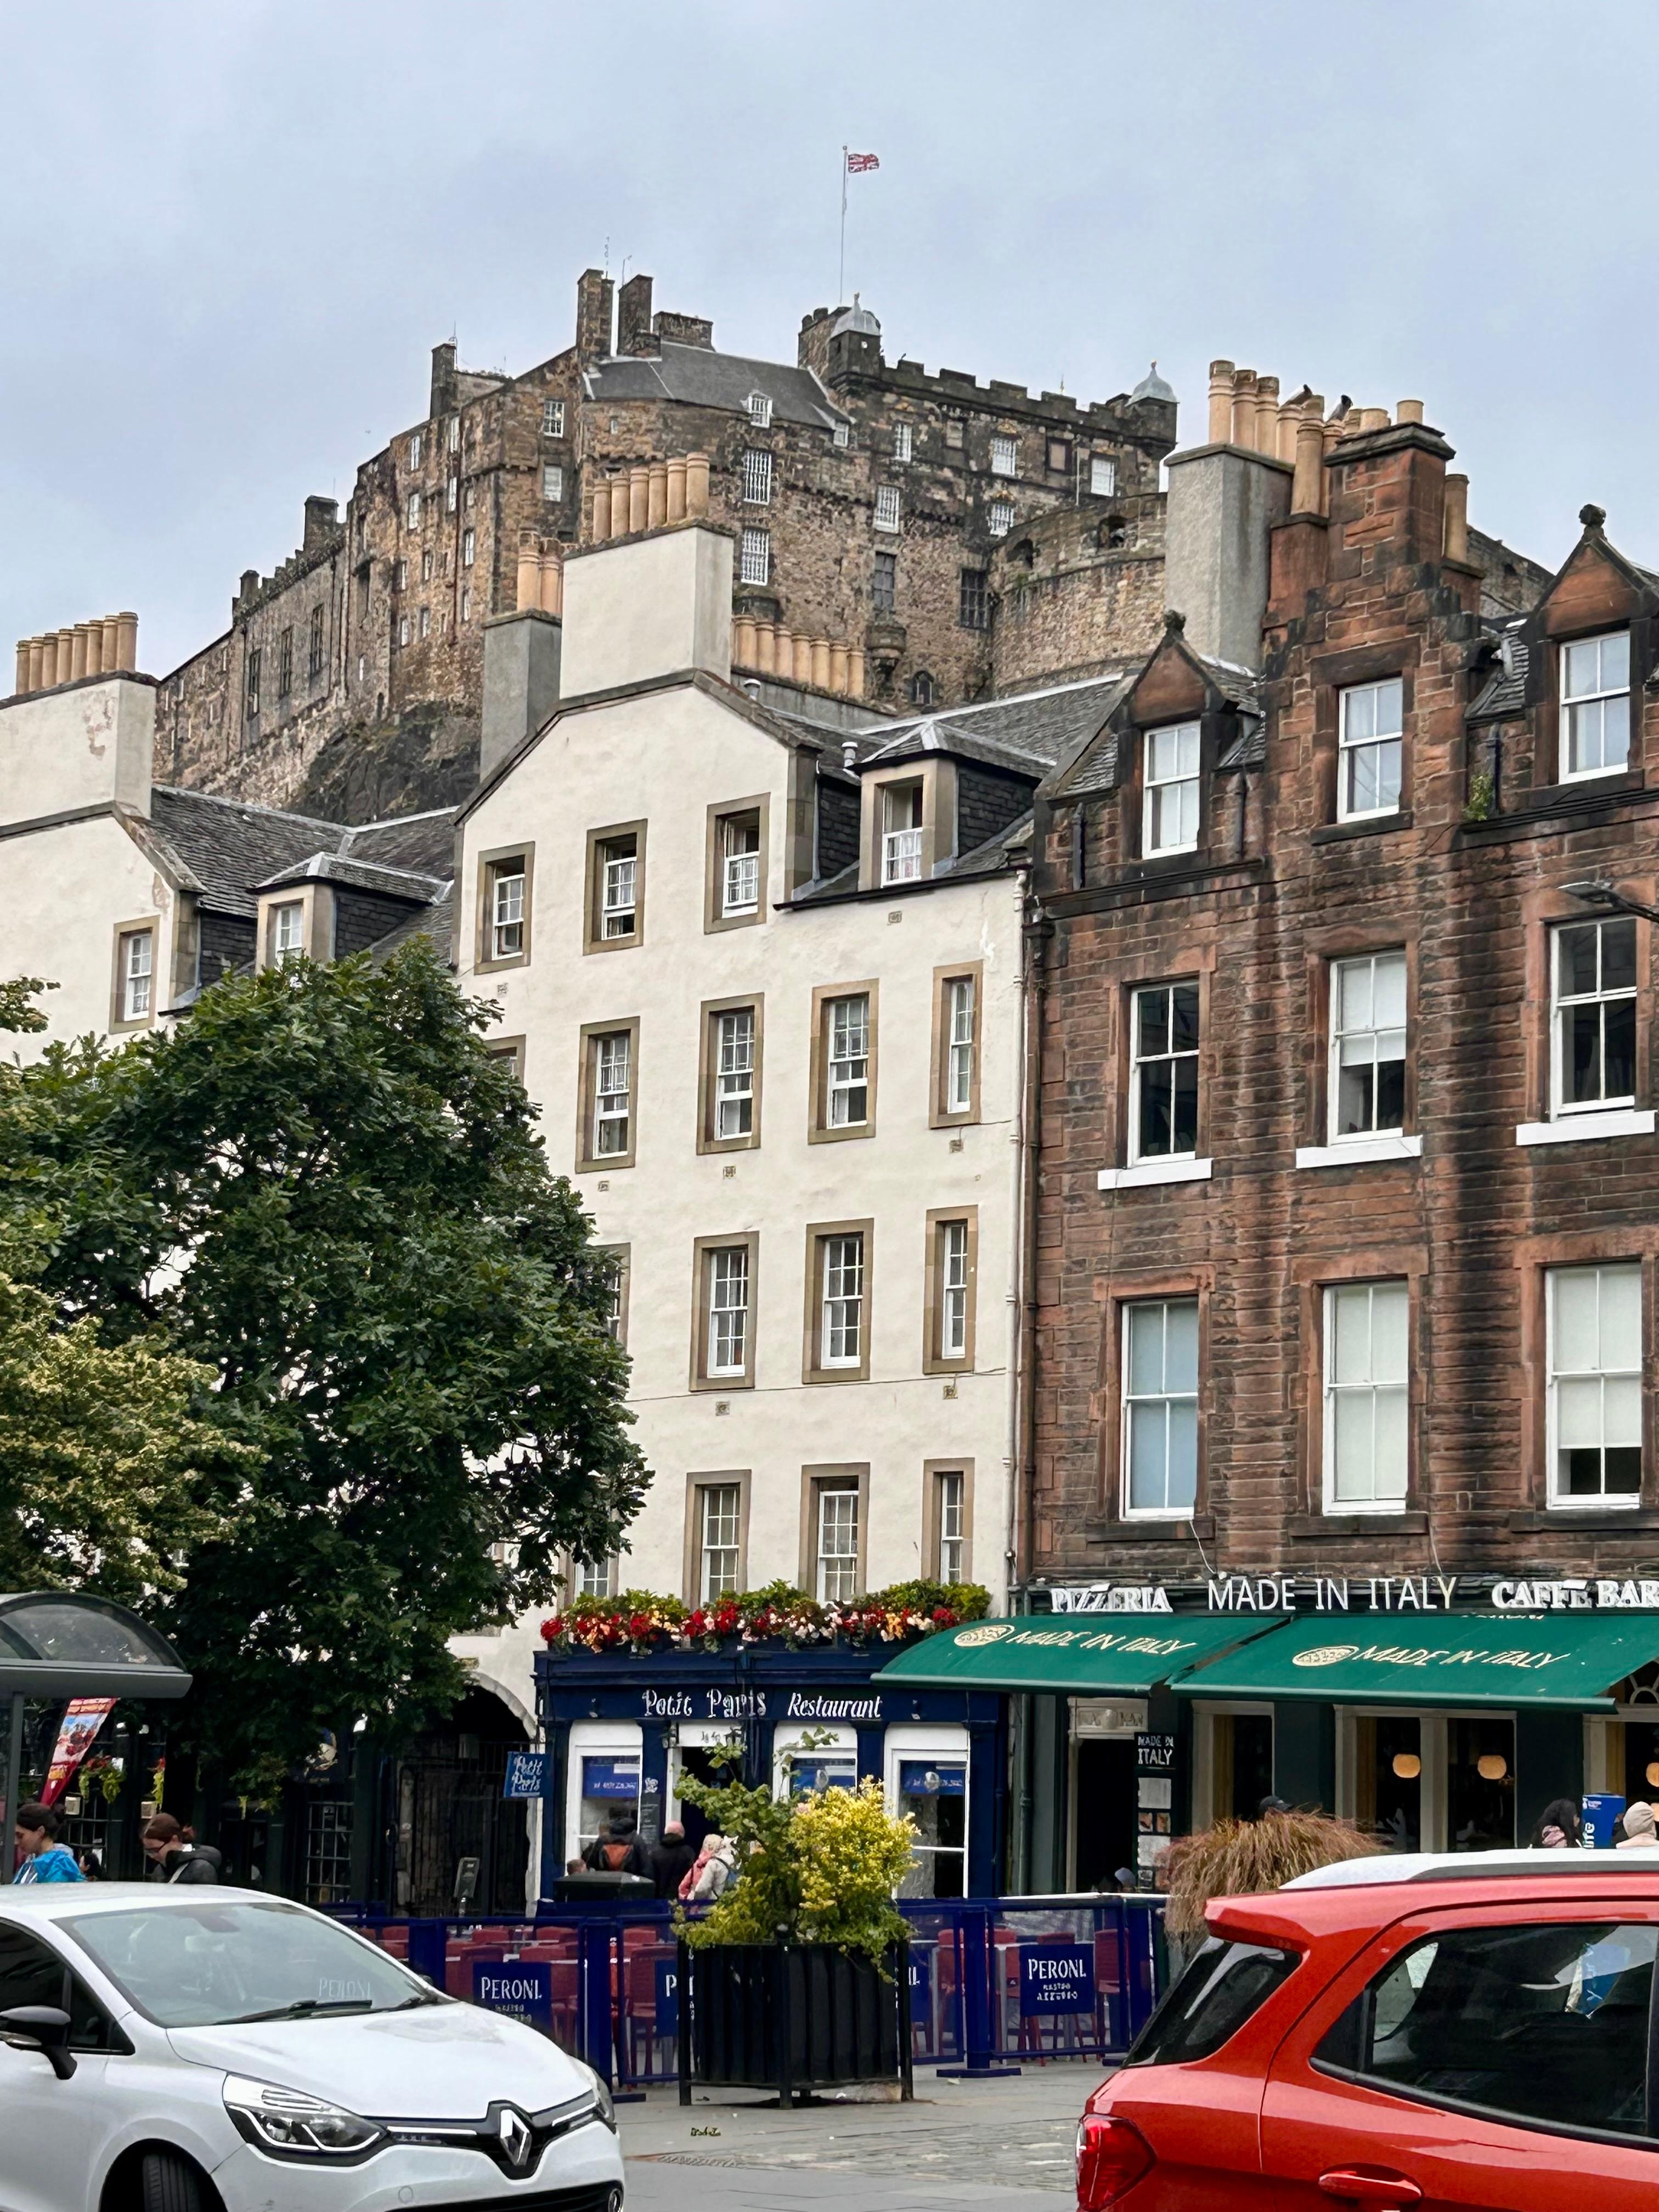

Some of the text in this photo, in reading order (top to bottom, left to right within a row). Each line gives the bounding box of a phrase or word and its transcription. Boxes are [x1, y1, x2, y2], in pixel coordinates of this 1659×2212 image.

[1050, 1587, 1173, 1613] PIZZERIA
[1208, 1577, 1457, 1611] MADE IN ITALY
[1595, 1579, 1659, 1609] BAR
[1006, 1630, 1198, 1655] MADE IN ITALY
[1352, 1645, 1571, 1669] MADE IN ITALY
[641, 1688, 882, 1718] Petit Paris Restaurant
[1138, 1735, 1174, 1747] MADE IN
[1138, 1748, 1173, 1765] ITALY
[1028, 1958, 1087, 1980] PERONI
[481, 1977, 543, 2000] PERONI
